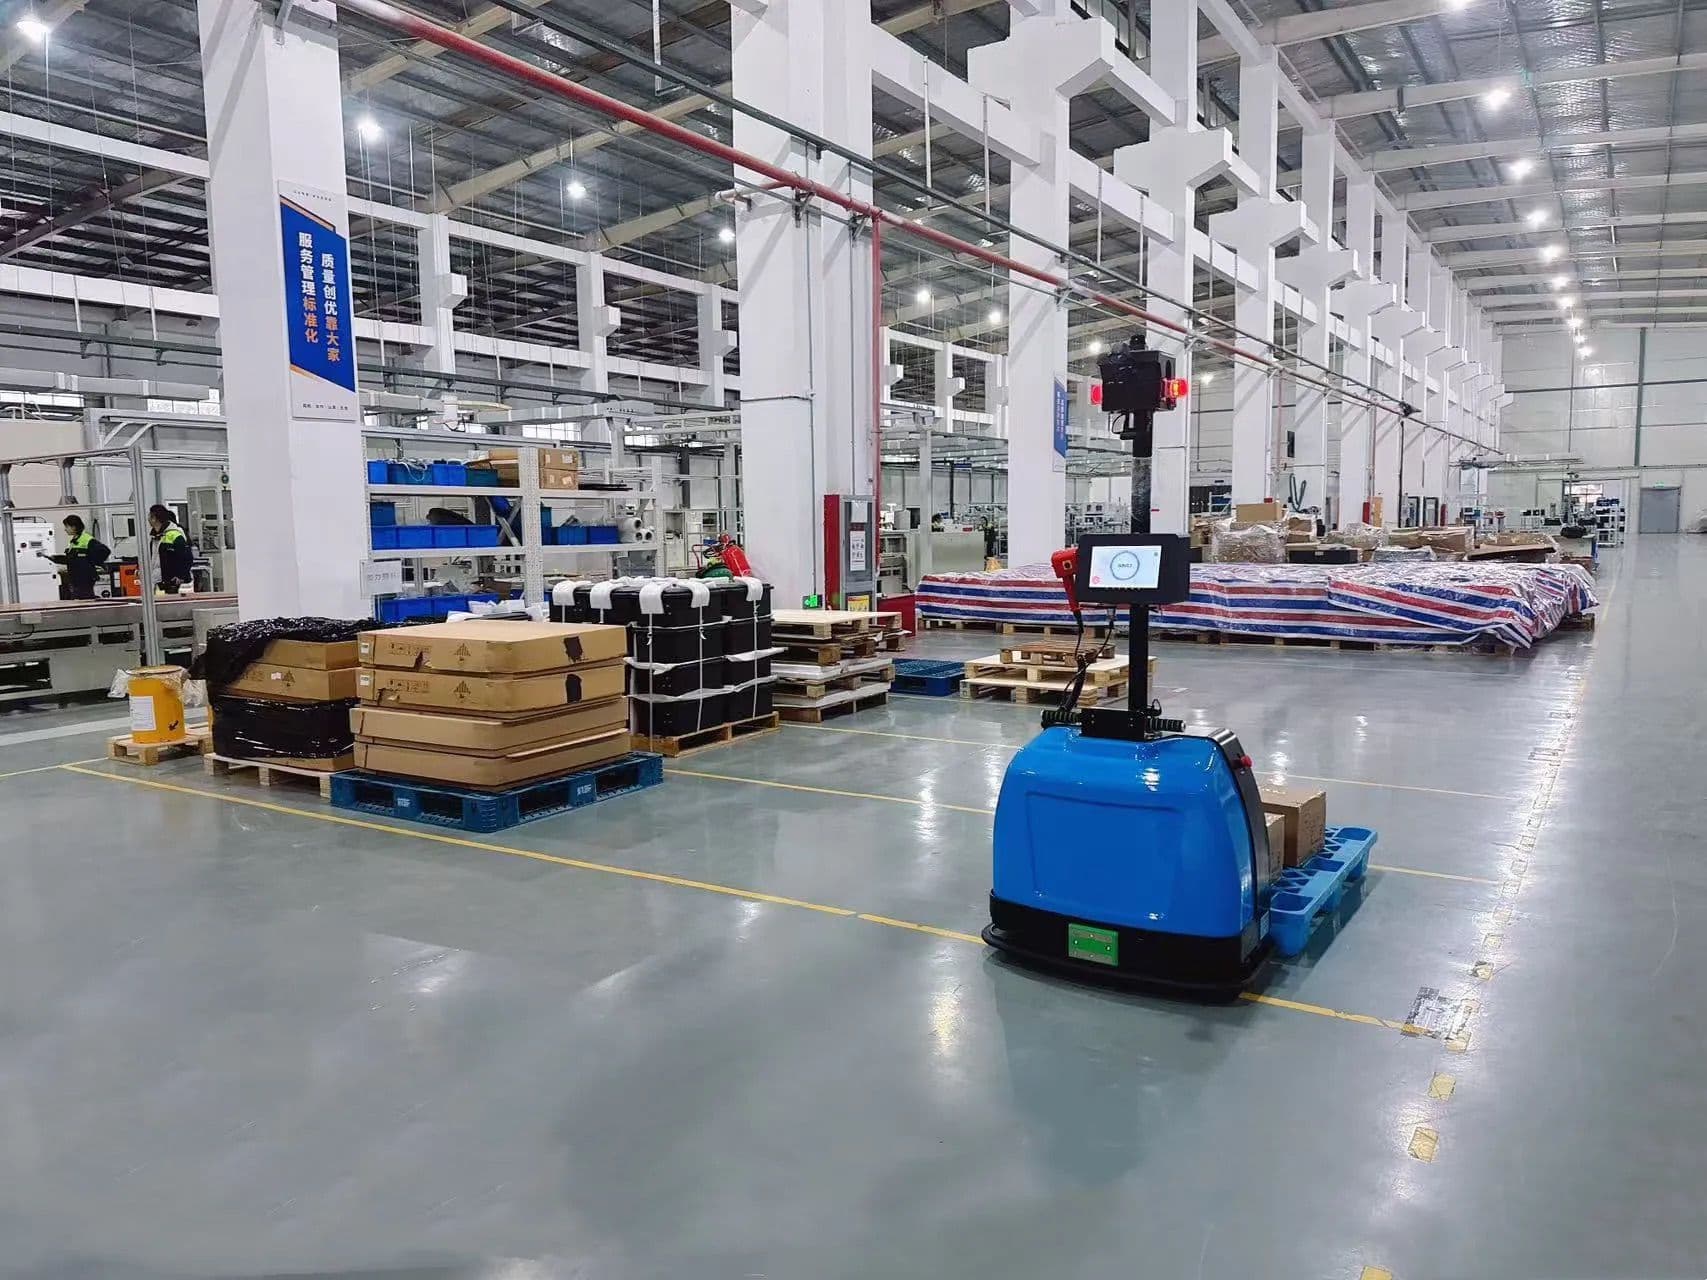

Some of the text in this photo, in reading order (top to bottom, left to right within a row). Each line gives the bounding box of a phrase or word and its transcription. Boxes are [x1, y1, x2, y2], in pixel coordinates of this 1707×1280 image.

[299, 231, 319, 344] 服务管理标准化
[321, 252, 340, 362] 质量创优靠大家
